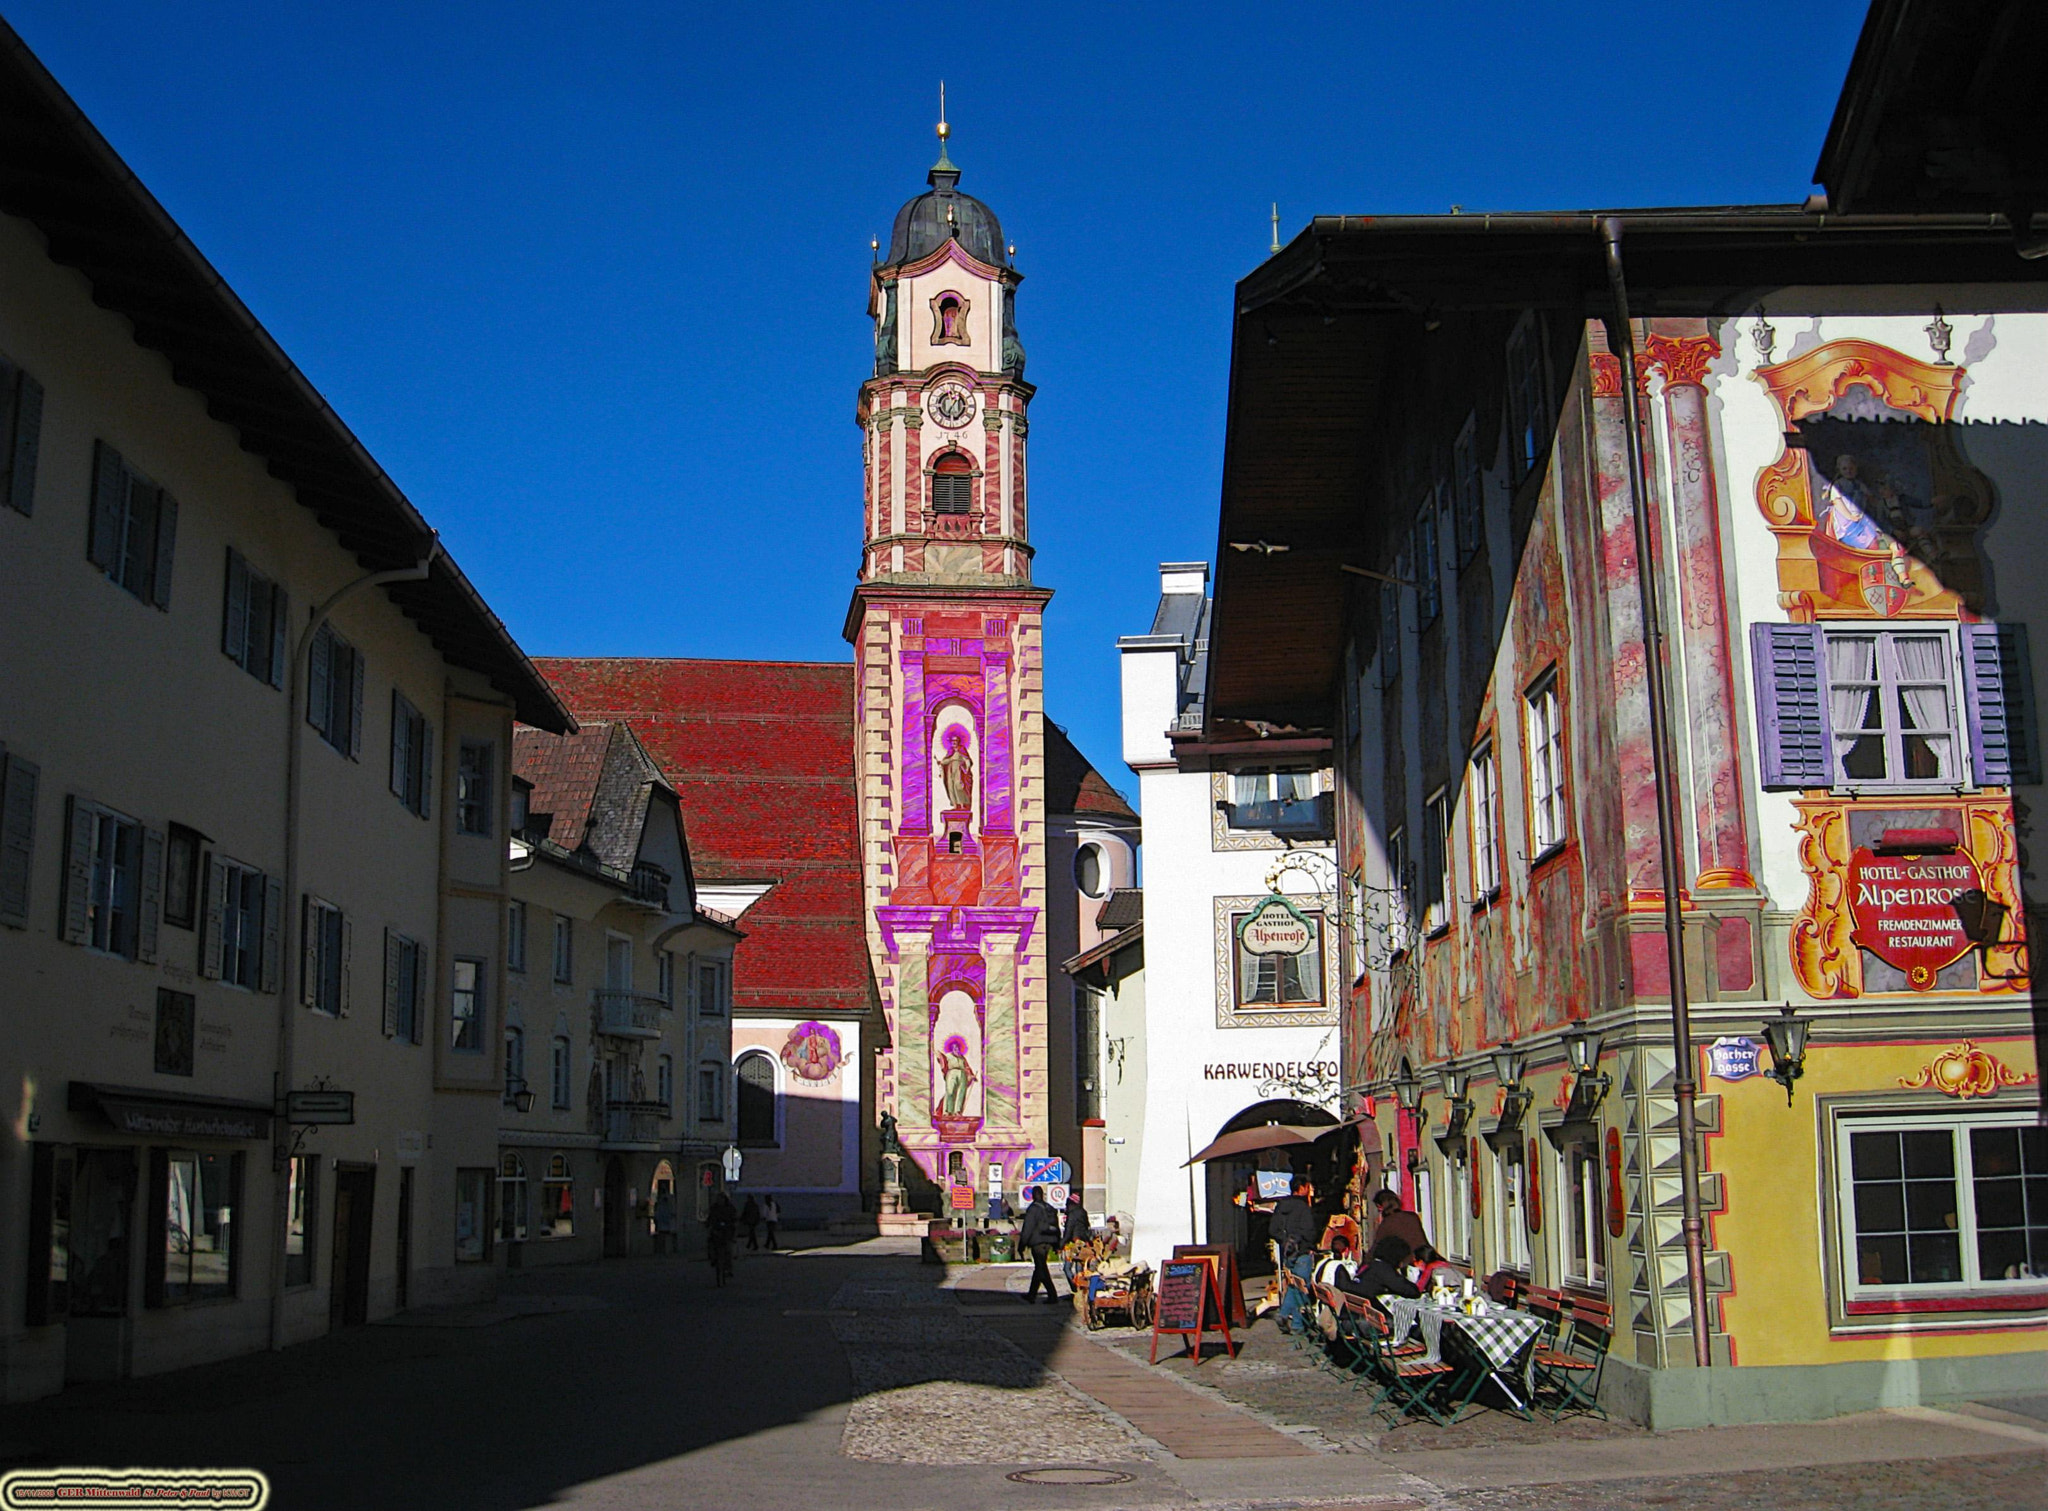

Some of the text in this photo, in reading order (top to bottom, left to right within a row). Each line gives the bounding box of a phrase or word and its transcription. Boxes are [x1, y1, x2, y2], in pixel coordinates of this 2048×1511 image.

[936, 430, 968, 440] 1746
[1859, 866, 1970, 880] HOTEL-GASTHOF
[1878, 919, 1963, 931] FREMDENZIMMER
[1888, 936, 1954, 947] RESTAURANT
[1054, 1190, 1063, 1198] 10
